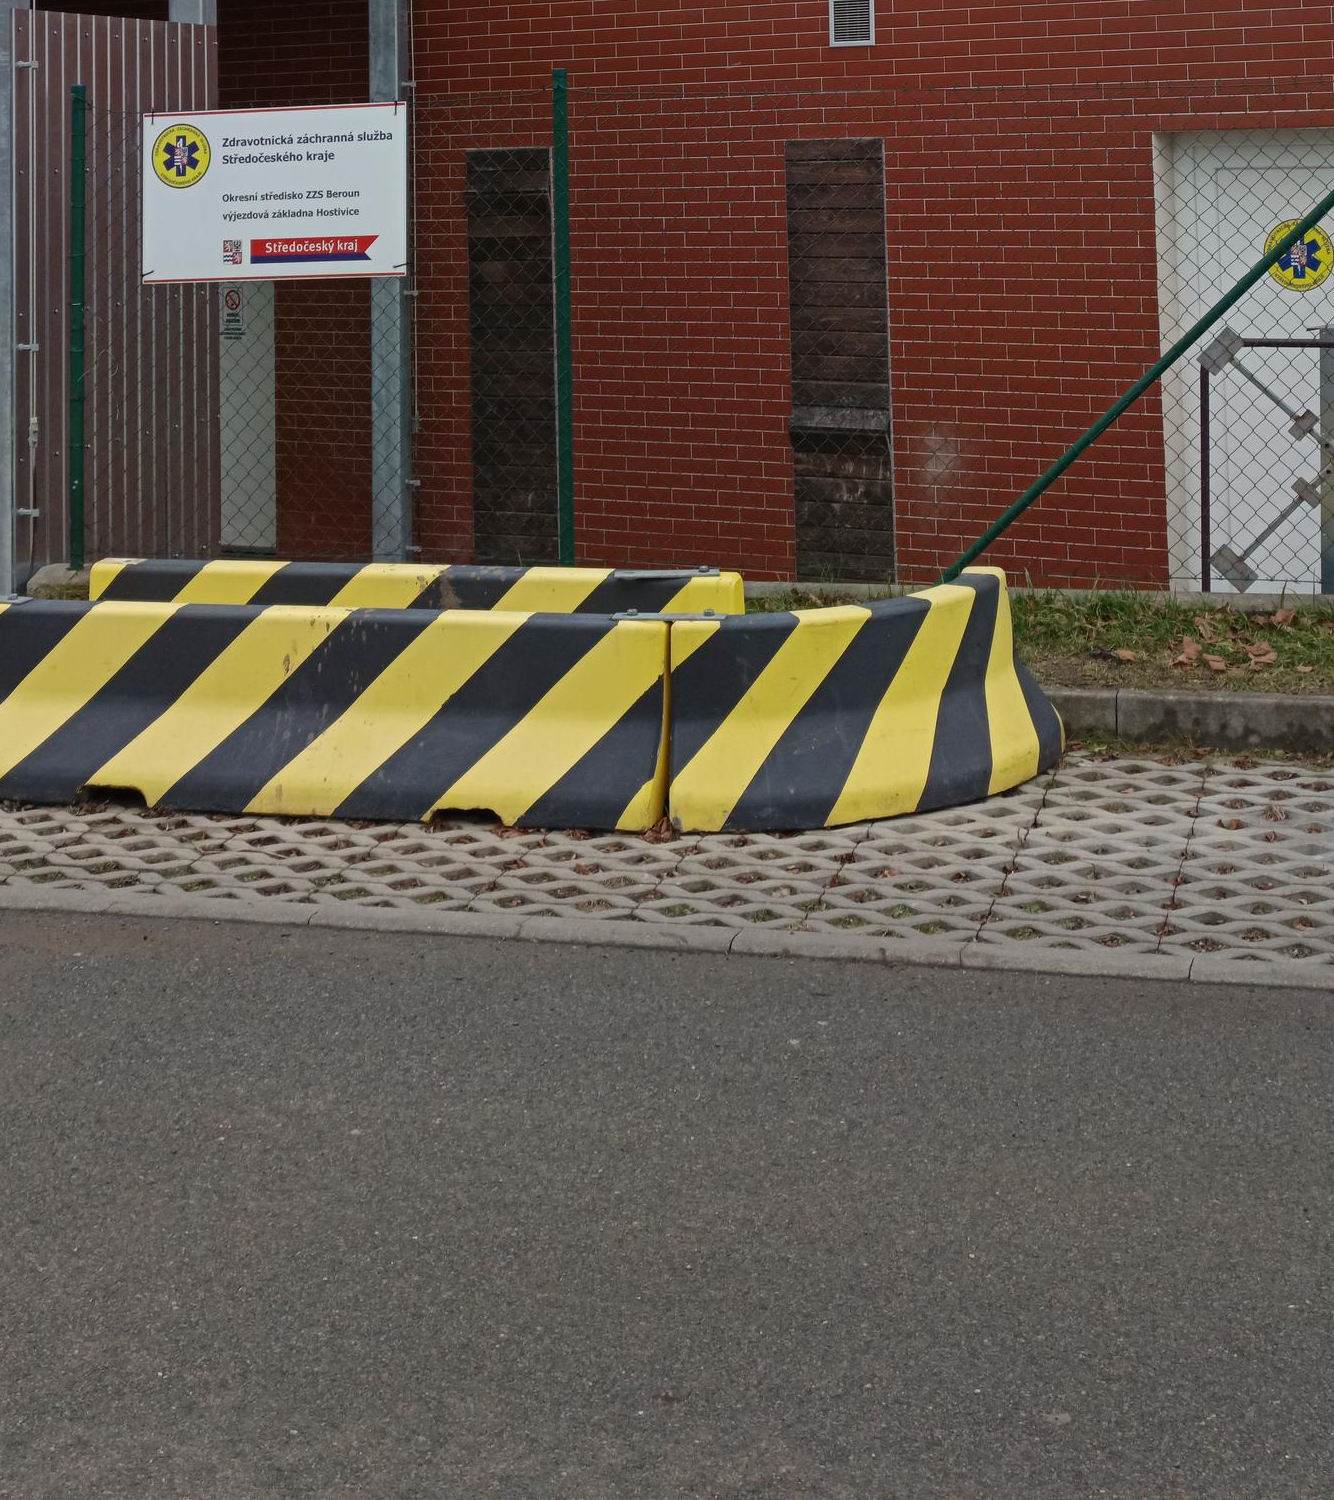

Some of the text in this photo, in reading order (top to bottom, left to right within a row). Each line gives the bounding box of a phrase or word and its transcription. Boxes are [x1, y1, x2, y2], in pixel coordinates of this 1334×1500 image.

[222, 133, 294, 148] Zdravotnická
[297, 131, 354, 145] záchranná
[357, 129, 393, 142] služba
[222, 150, 335, 165] Středočeského kraje
[222, 188, 360, 203] Okresní středisko ZZS Beroun
[222, 206, 360, 222] výjezdová základna Hostivice
[265, 239, 358, 254] Středočeský kraj
